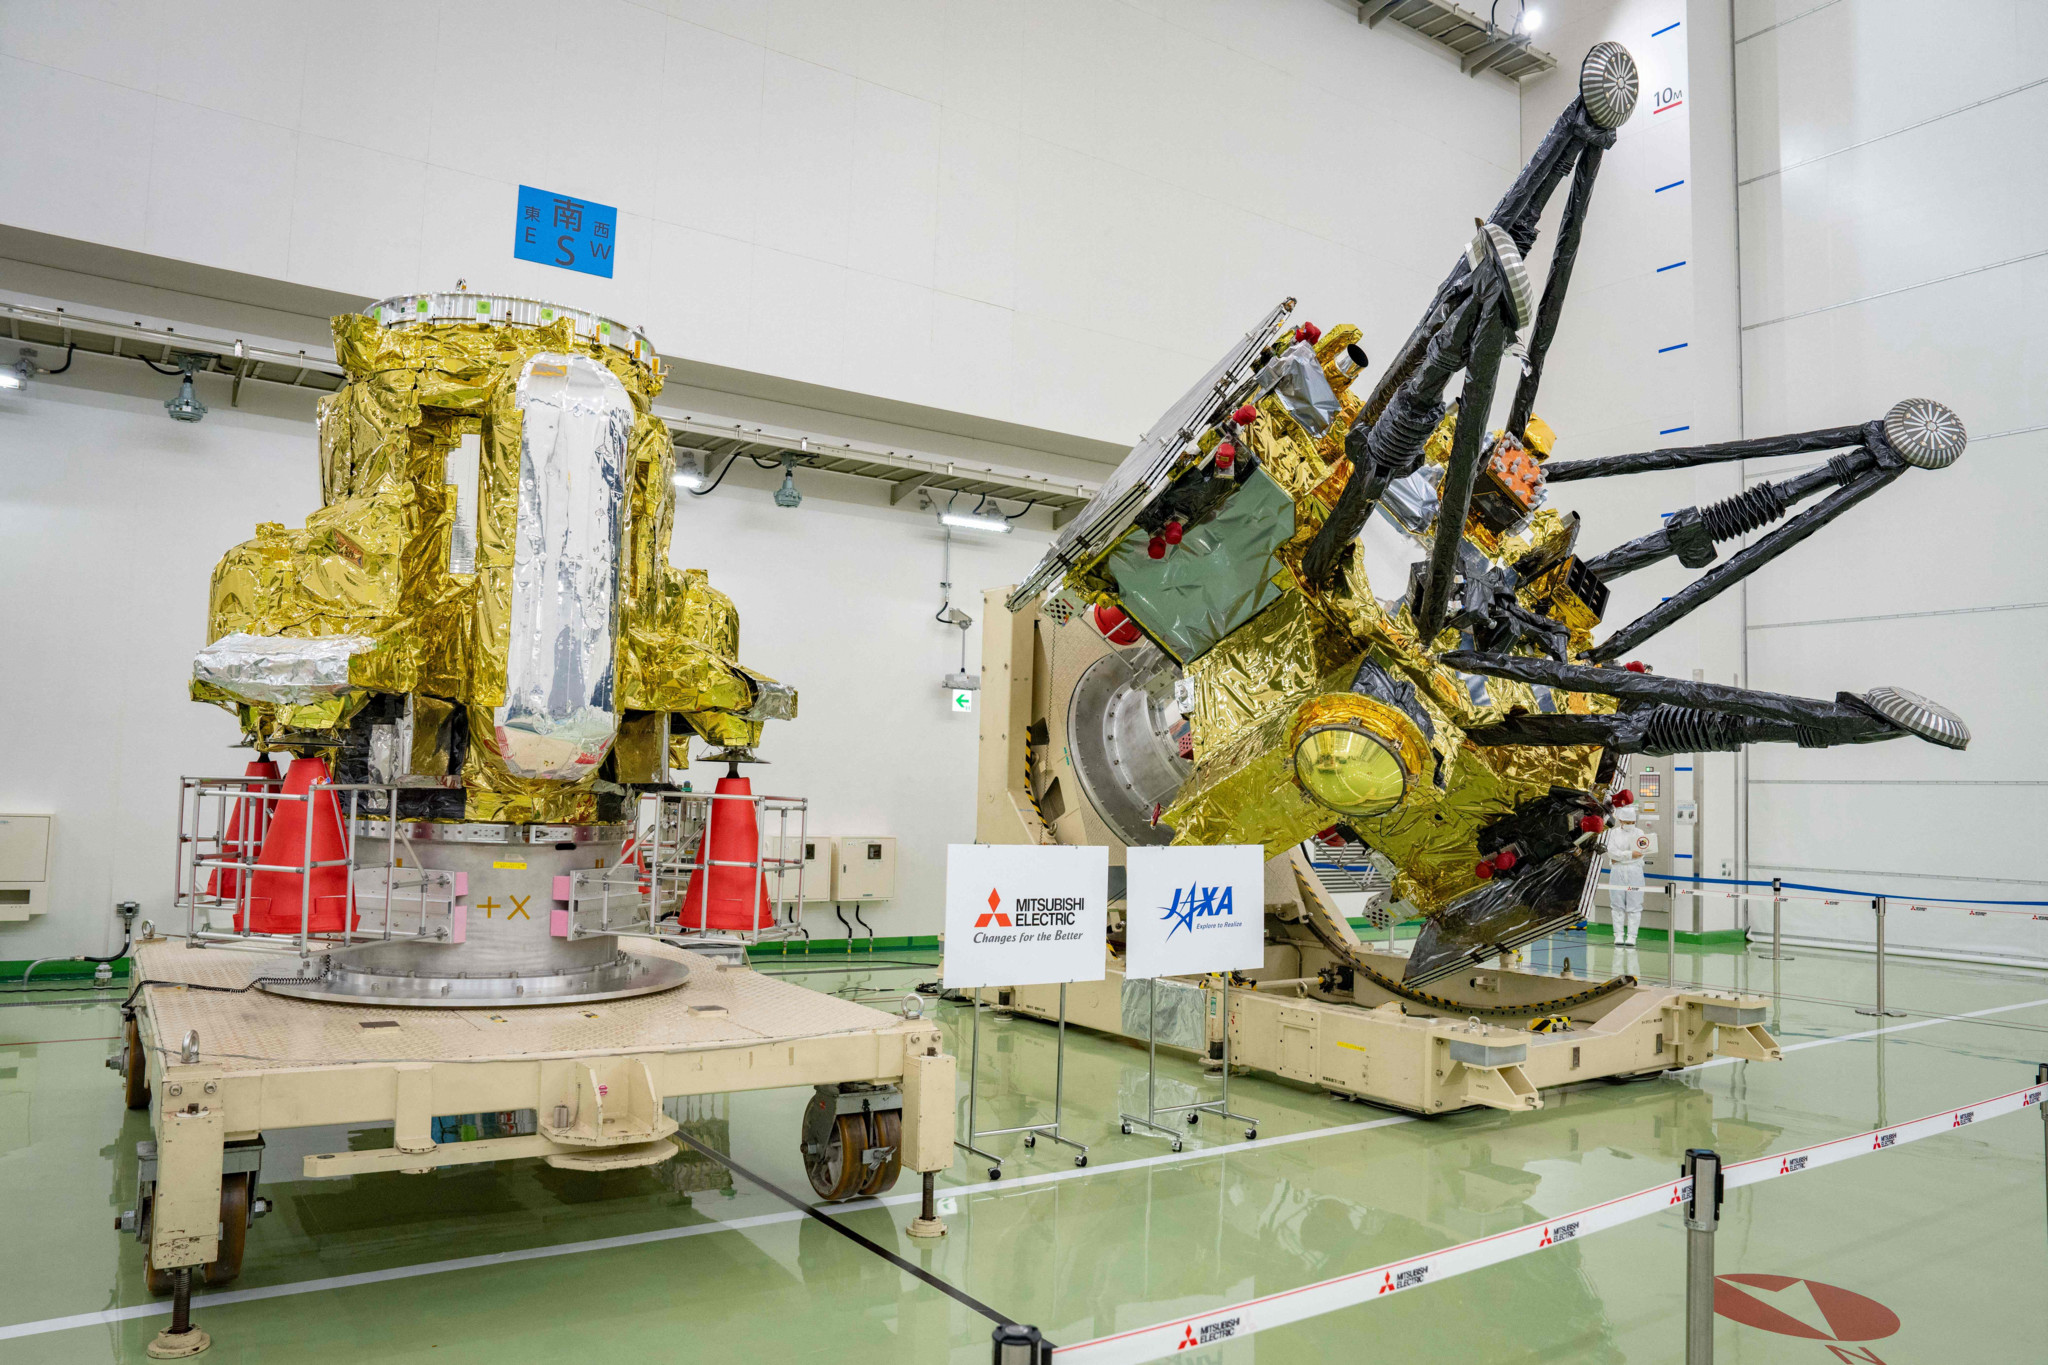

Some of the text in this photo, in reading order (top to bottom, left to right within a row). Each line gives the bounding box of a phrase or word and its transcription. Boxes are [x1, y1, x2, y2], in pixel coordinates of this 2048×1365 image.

[524, 205, 541, 222] 東
[553, 198, 585, 232] 南
[525, 226, 537, 244] E
[593, 221, 610, 239] 西
[555, 235, 575, 266] S
[589, 240, 612, 260] W
[1015, 897, 1085, 912] MITSUBISHI
[1157, 881, 1233, 943] JAXA
[1015, 912, 1076, 927] ELECTRIC
[1196, 922, 1216, 930] Explore
[973, 929, 1084, 945] Changes for the Better
[1200, 1317, 1240, 1335] MITSUBISHI
[1200, 1327, 1235, 1344] ELECTRIC
